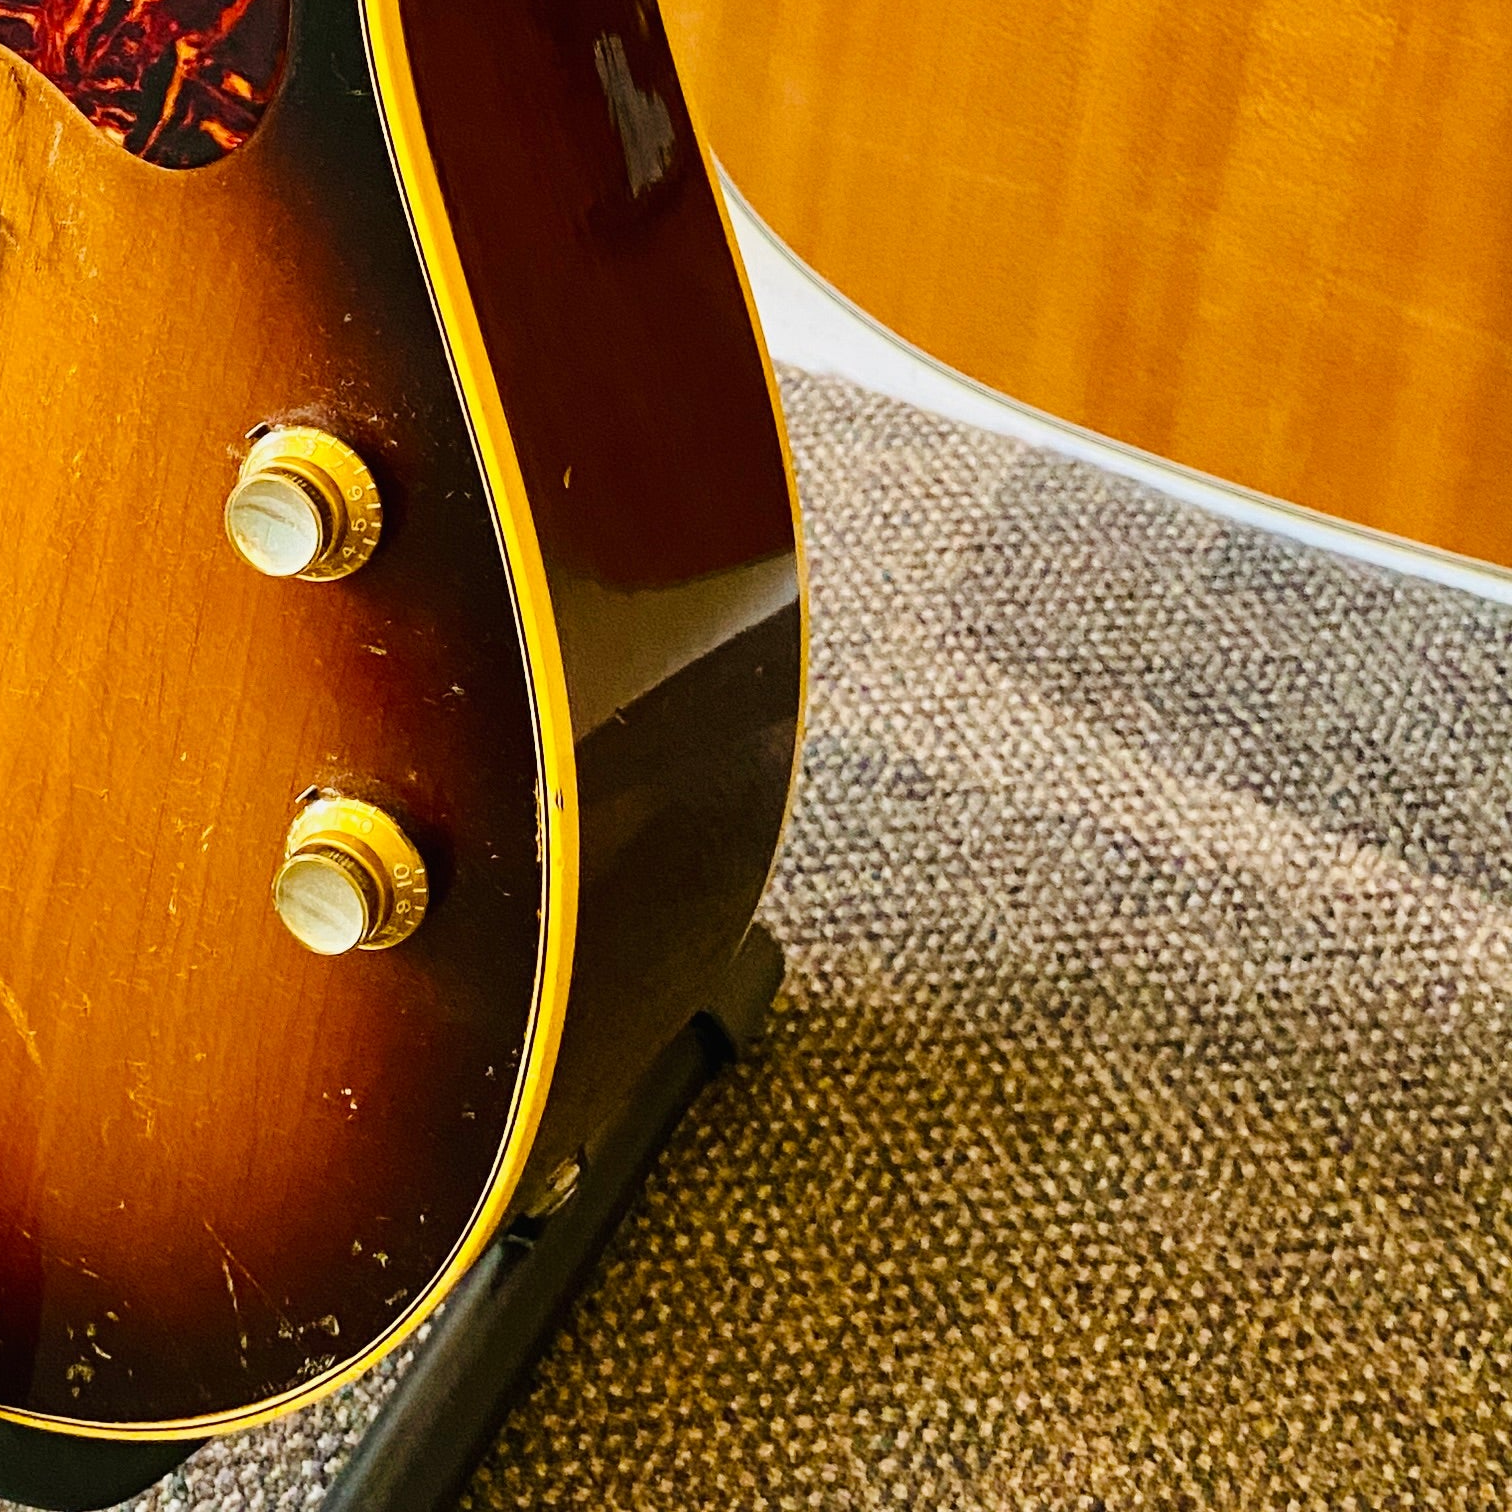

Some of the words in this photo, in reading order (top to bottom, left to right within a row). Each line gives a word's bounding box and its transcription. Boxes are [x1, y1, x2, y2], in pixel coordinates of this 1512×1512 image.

[347, 485, 363, 501] 6
[351, 518, 367, 532] 5
[343, 546, 357, 558] 4
[393, 863, 413, 888] 10
